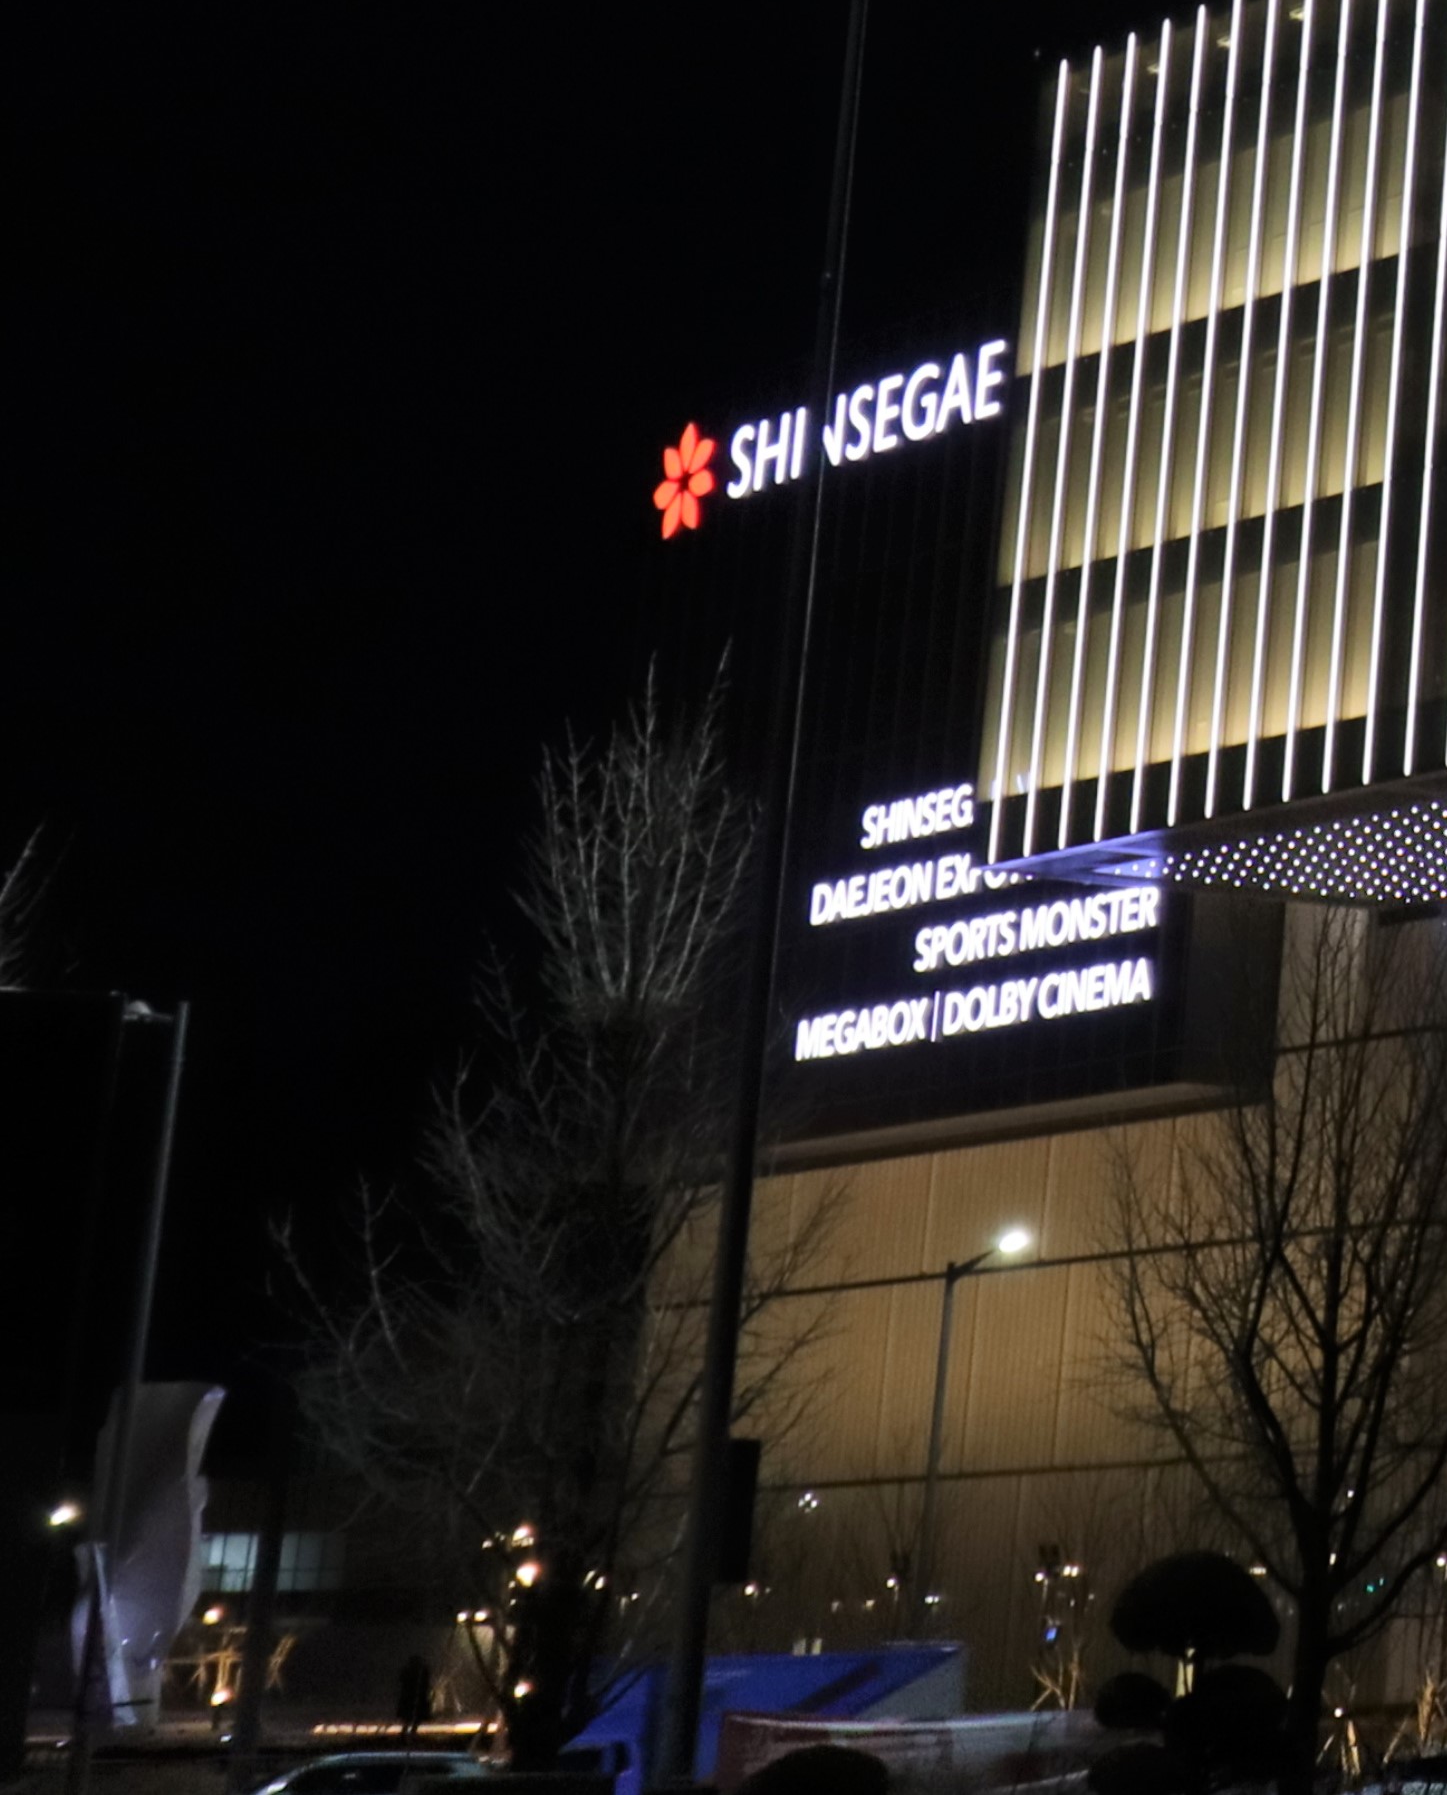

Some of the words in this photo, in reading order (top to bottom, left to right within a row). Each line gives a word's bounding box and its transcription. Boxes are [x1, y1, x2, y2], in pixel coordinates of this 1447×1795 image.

[860, 783, 974, 849] SHINSEG
[809, 861, 932, 926] DAEJEON
[913, 908, 1018, 973] SPORTS
[1019, 886, 1160, 953] MONSTER
[795, 997, 931, 1062] MEGABOX
[942, 977, 1039, 1036] DOLBY
[1038, 957, 1152, 1019] CINEMA
